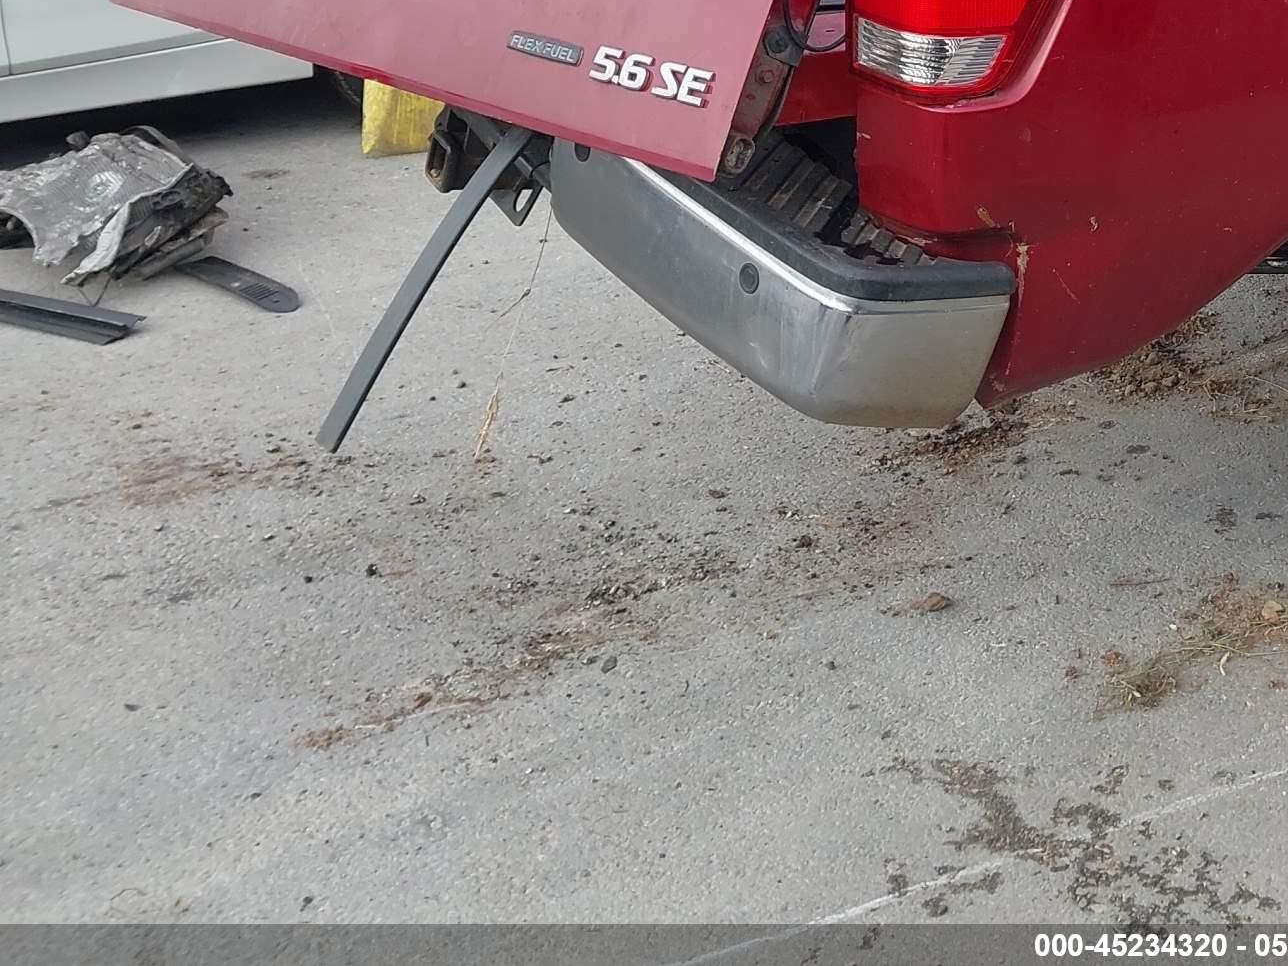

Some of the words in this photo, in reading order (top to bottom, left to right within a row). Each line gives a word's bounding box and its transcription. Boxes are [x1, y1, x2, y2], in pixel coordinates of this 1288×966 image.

[510, 34, 543, 53] FLEX
[540, 43, 574, 63] FUEL
[588, 45, 654, 91] 5.6
[650, 61, 715, 108] SE
